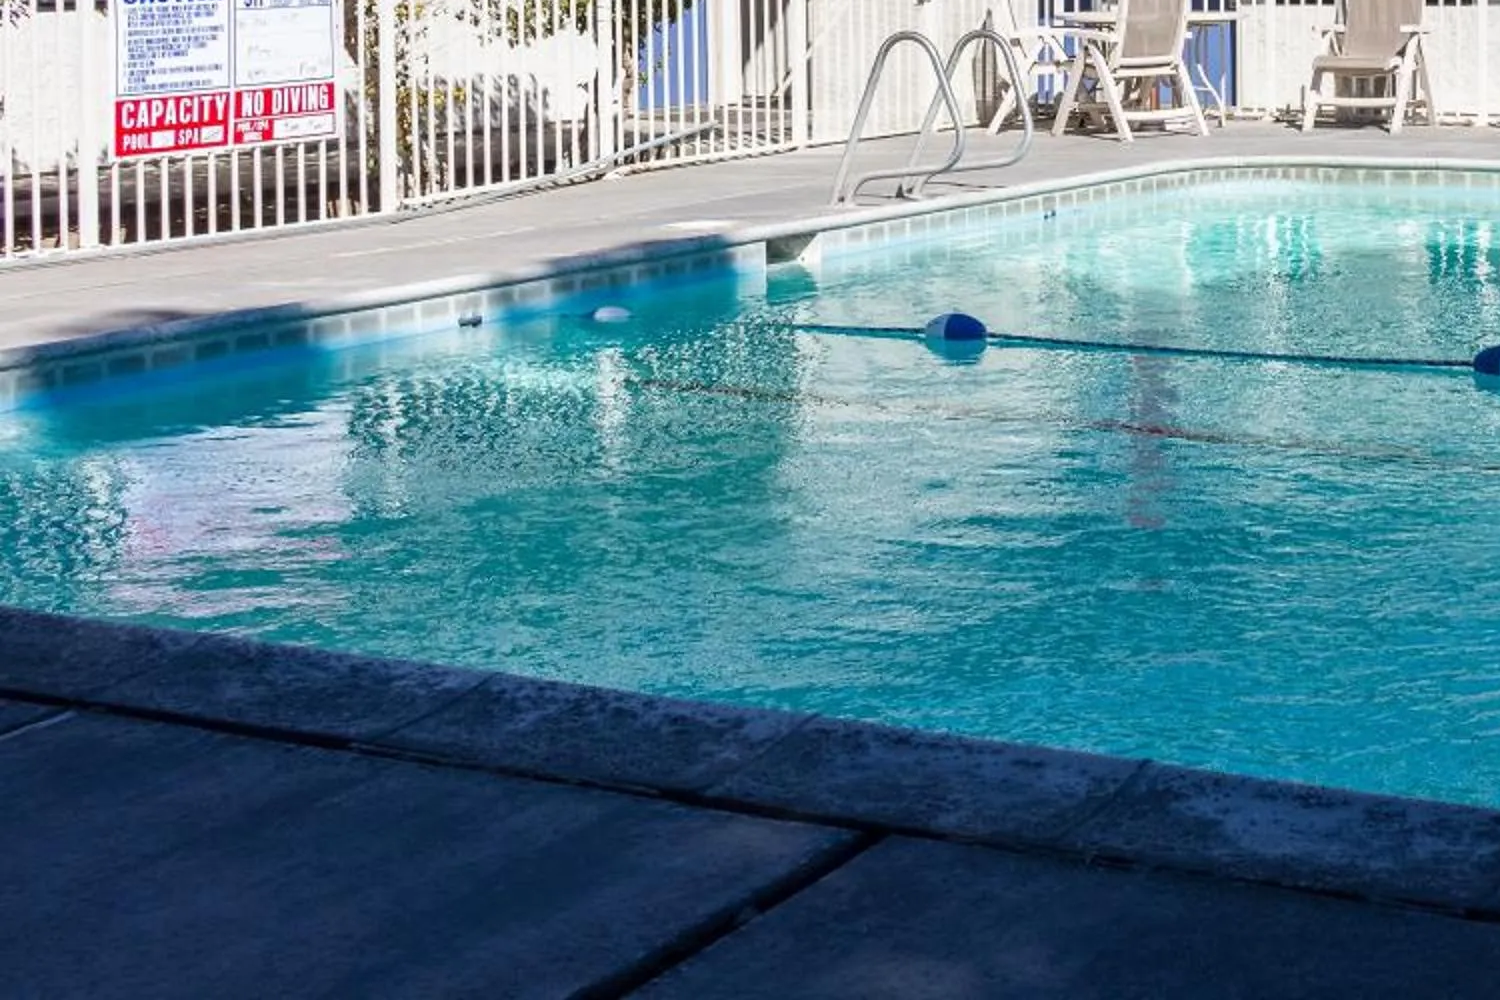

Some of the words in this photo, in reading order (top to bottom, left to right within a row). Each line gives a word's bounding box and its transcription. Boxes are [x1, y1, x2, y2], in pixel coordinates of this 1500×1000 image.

[121, 94, 227, 129] CAPACITY
[242, 88, 264, 117] NO
[271, 84, 329, 115] DIVING
[123, 133, 149, 150] POOL
[178, 127, 199, 145] SPA
